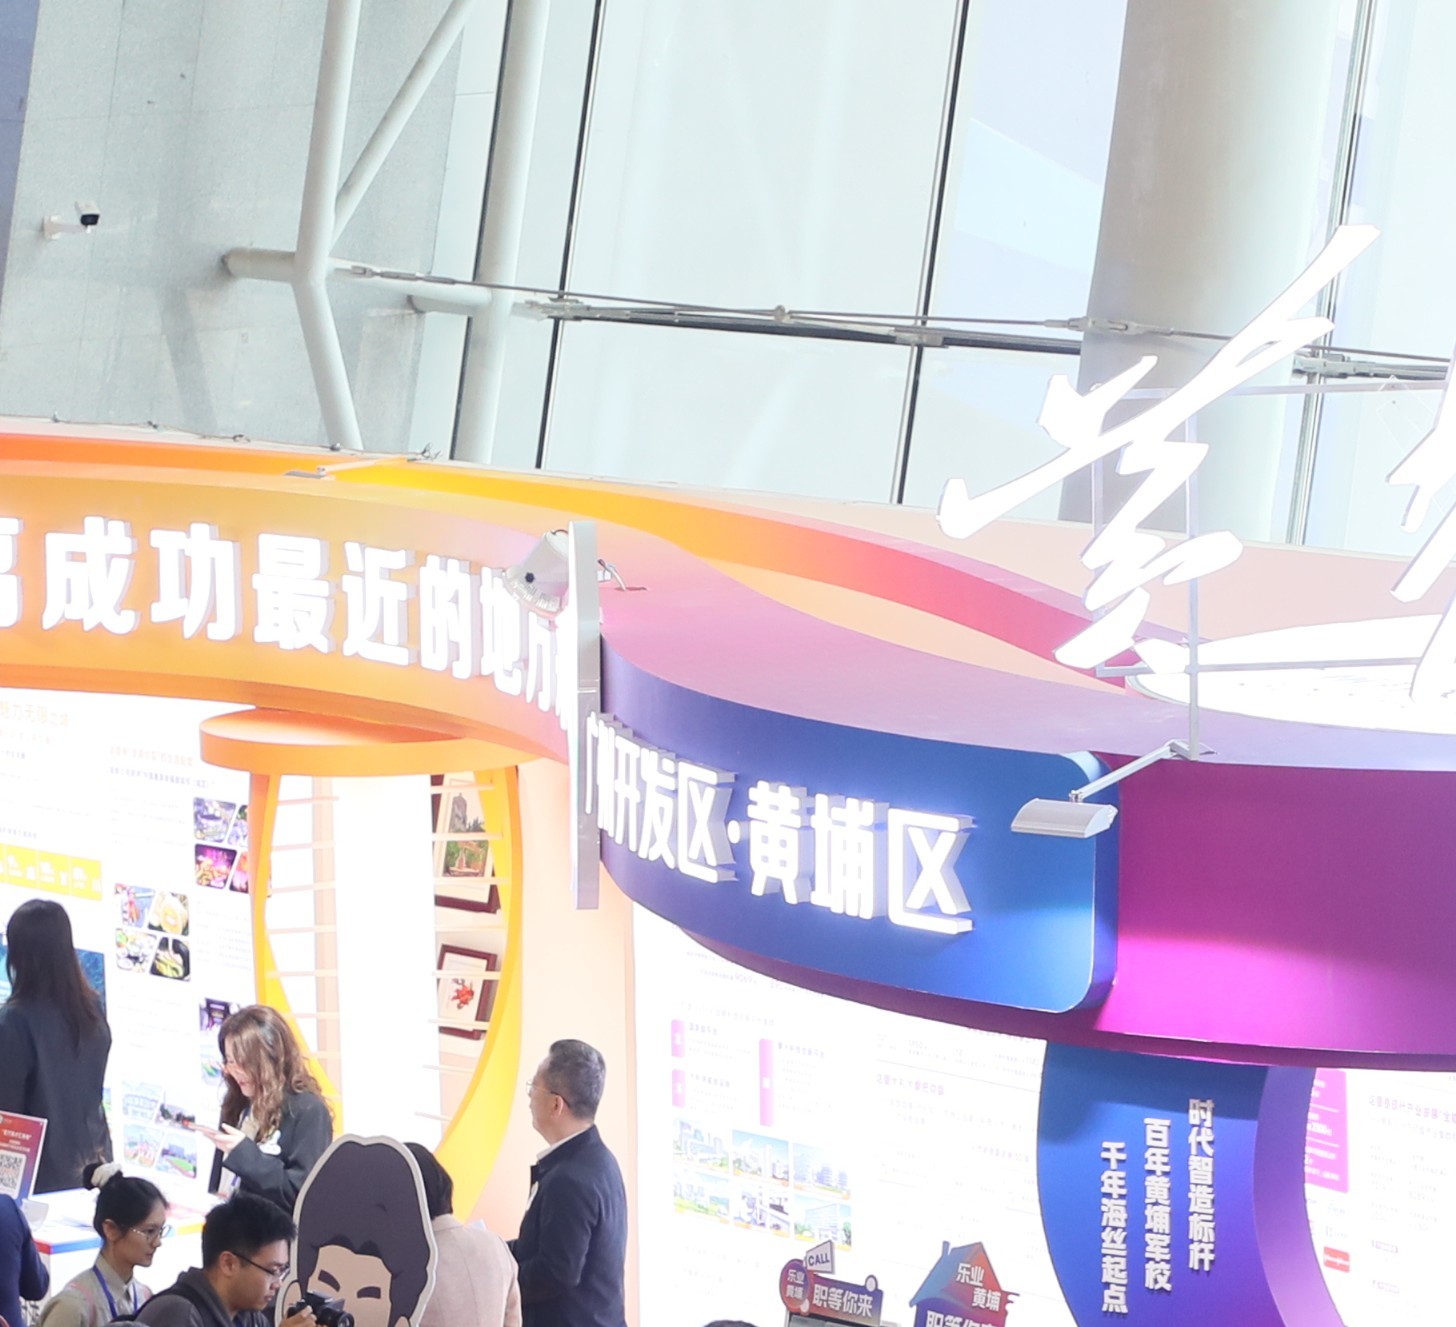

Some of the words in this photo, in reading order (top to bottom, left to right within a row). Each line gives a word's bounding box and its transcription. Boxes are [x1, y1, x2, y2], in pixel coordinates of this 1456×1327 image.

[1188, 1097, 1216, 1273] 时代智造标杆
[1144, 1117, 1172, 1293] 百年黄埔军校
[1100, 1140, 1129, 1315] 千年海丝起点
[807, 1252, 830, 1267] CALL
[785, 1268, 807, 1286] 乐业
[955, 1262, 985, 1287] 乐业
[785, 1283, 805, 1301] 黄埔
[812, 1284, 874, 1318] 职等你来
[971, 1287, 1002, 1312] 黄埔
